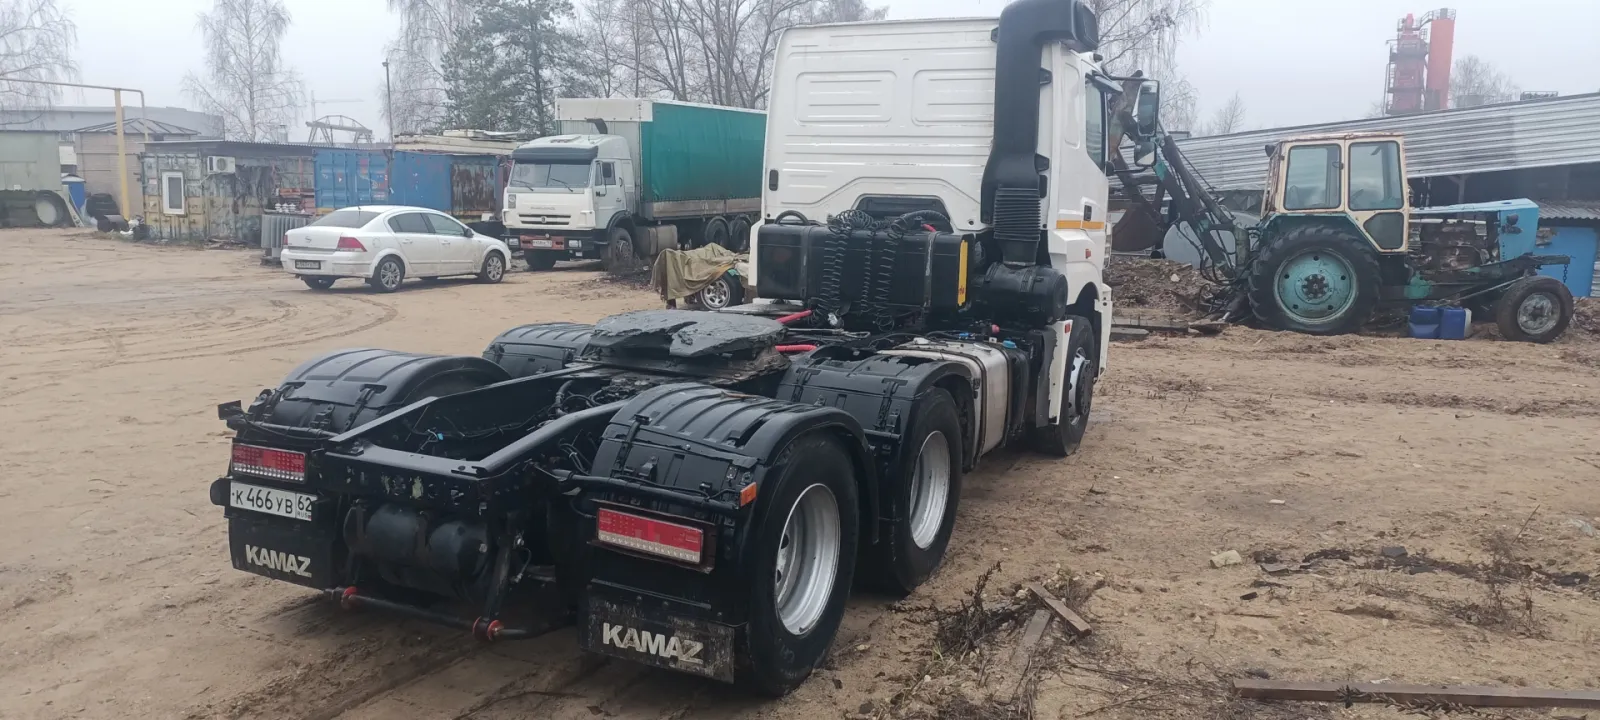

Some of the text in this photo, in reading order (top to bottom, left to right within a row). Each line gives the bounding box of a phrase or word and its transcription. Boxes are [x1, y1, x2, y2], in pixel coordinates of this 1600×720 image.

[297, 495, 312, 512] 62
[245, 544, 312, 578] KAMAZ
[603, 622, 704, 664] KAMAZ
